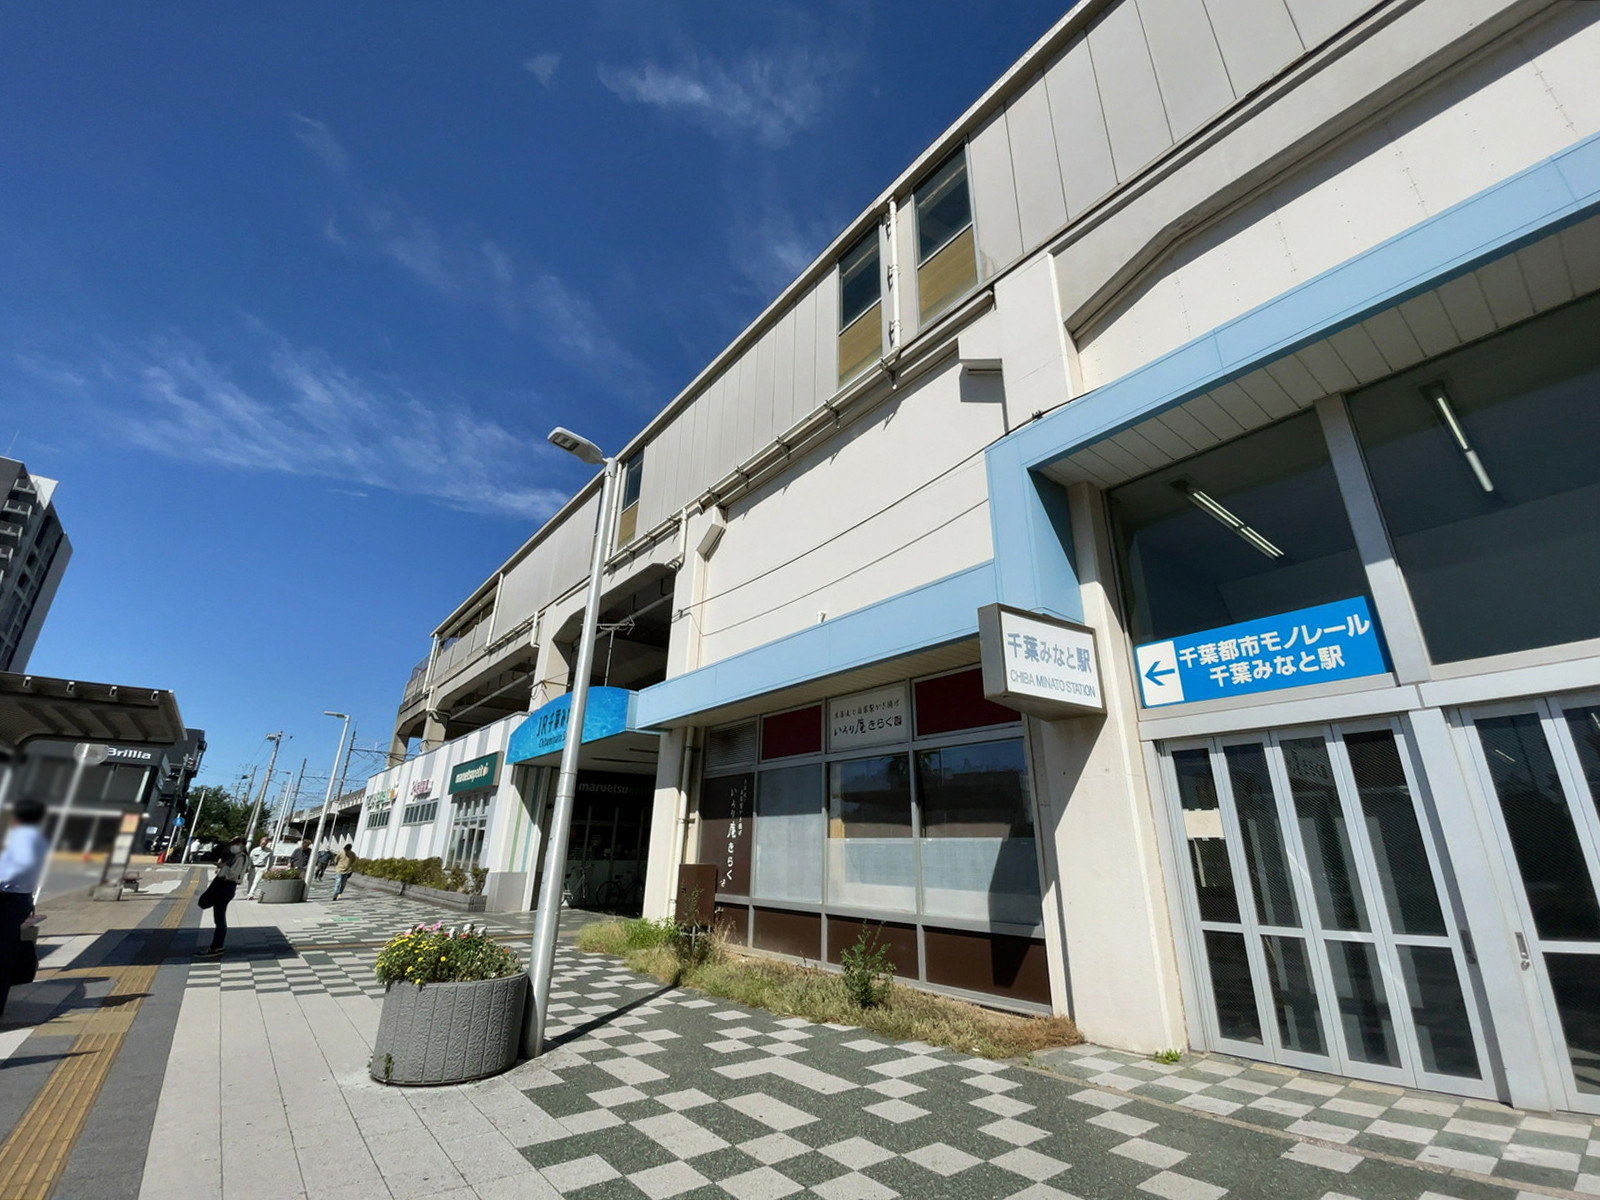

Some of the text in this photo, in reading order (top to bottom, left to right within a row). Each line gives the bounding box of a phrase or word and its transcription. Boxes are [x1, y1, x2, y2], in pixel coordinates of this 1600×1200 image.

[1007, 632, 1092, 674] 千葉みなと駅
[1179, 613, 1370, 668] 千葉都市モノレール
[1010, 669, 1096, 698] CHIBA MINATO STATION
[1209, 645, 1346, 687] 千葉みなと駅
[107, 747, 152, 760] Brillia
